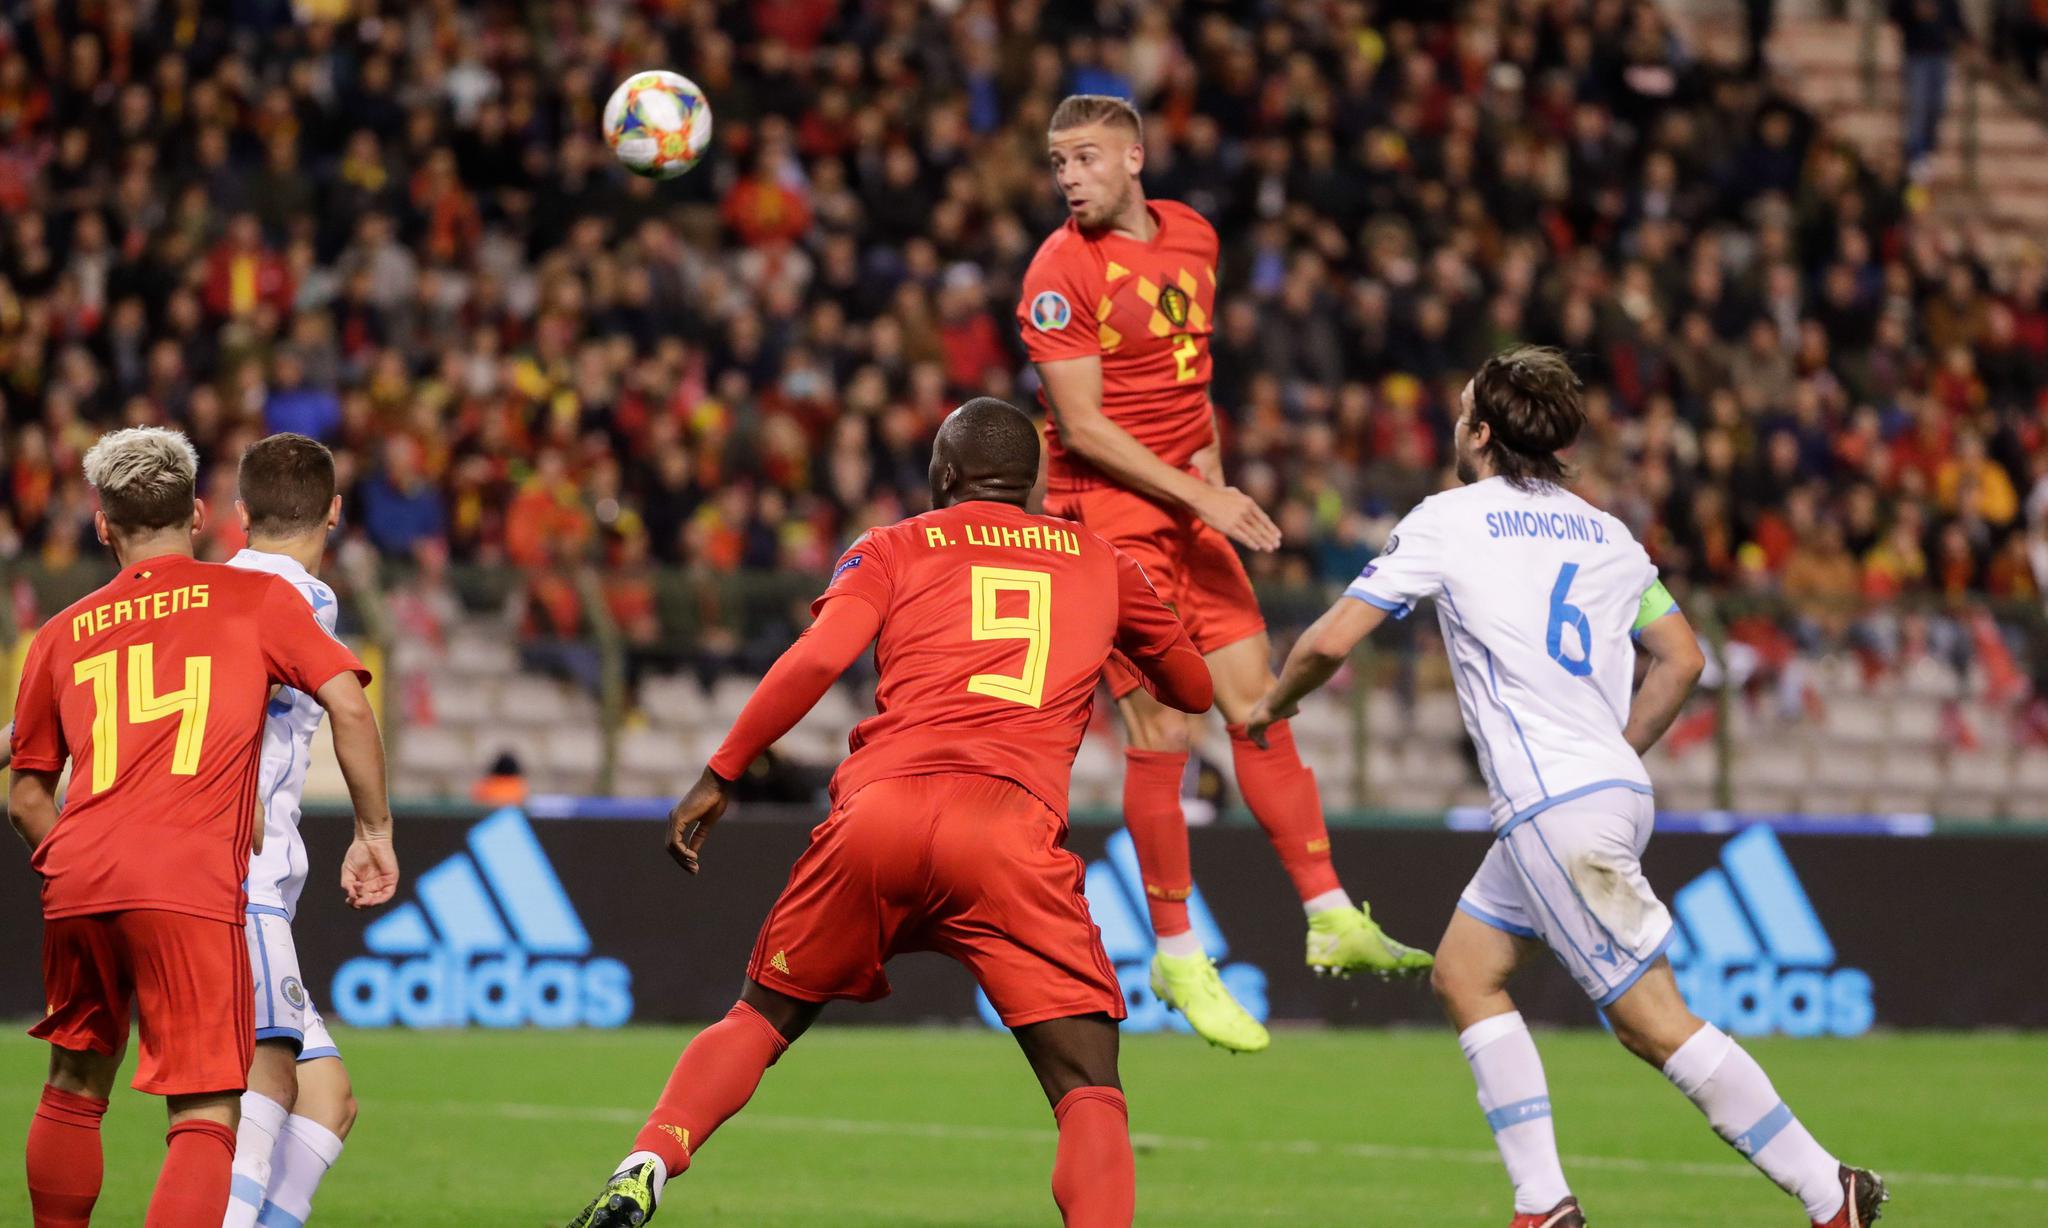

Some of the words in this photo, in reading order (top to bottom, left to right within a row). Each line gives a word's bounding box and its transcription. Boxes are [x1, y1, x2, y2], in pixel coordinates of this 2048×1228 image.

[1173, 333, 1198, 382] 2
[925, 527, 956, 548] R.
[965, 525, 1080, 556] LUKAKU
[1486, 511, 1590, 541] SIMONCINI
[1593, 519, 1609, 544] D.
[73, 584, 209, 642] MERTENS
[967, 566, 1051, 709] 9
[1546, 562, 1593, 677] 6
[73, 642, 211, 795] 14
[331, 948, 634, 1029] adidas
